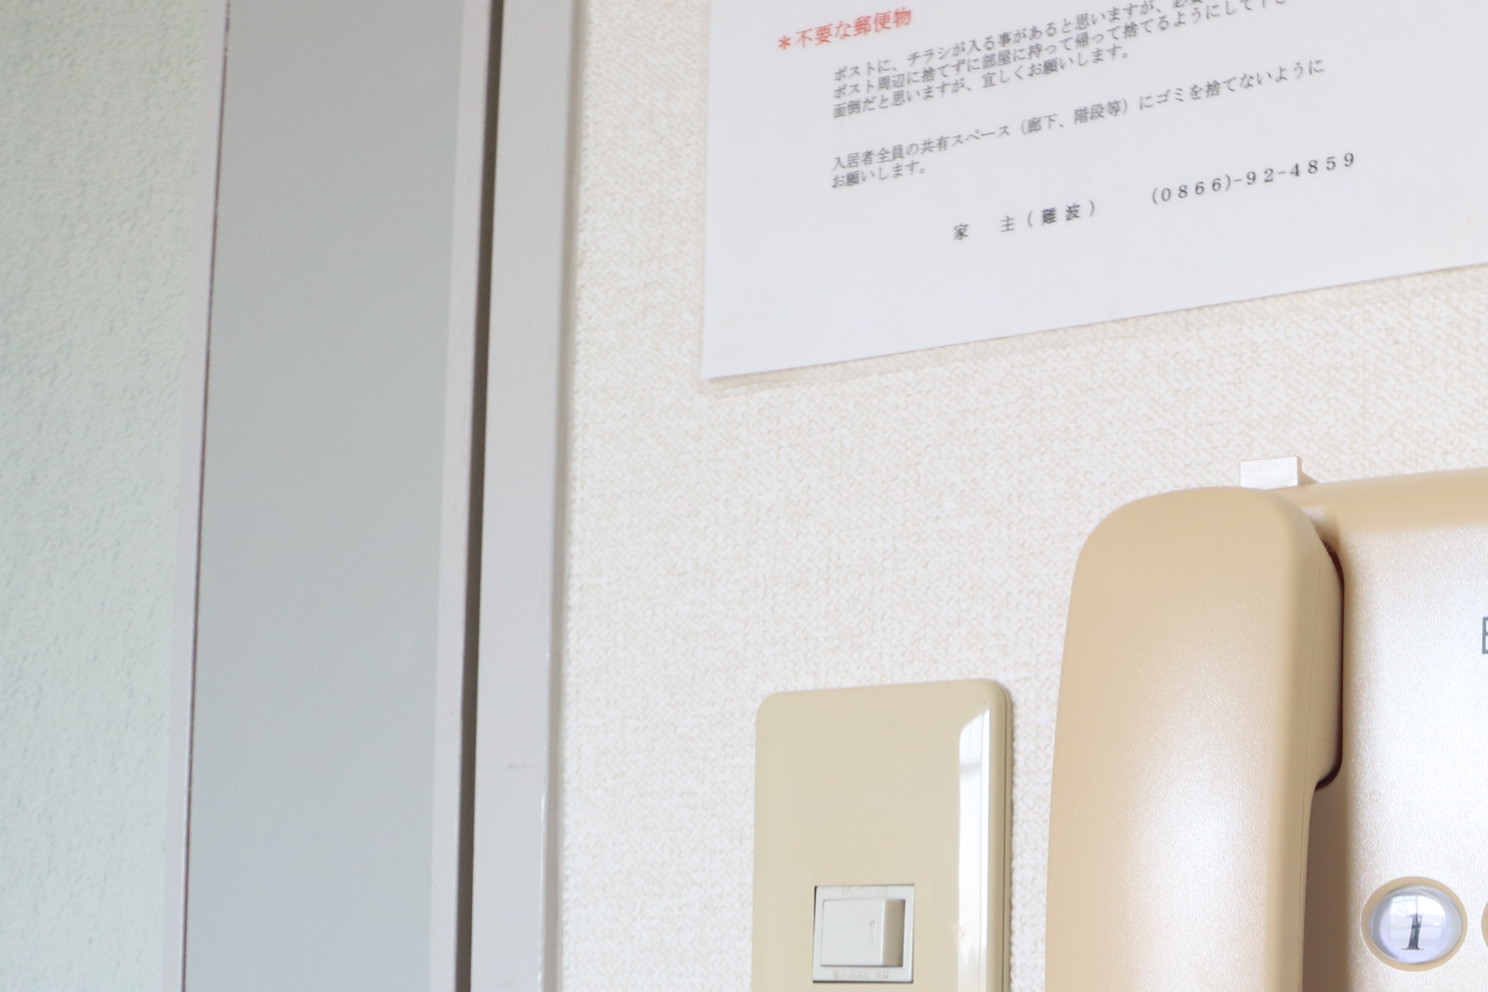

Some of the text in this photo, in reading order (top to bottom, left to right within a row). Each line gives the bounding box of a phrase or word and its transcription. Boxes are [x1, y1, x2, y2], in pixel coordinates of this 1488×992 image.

[831, 160, 926, 189] お願いします。
[1401, 912, 1422, 951] 1
